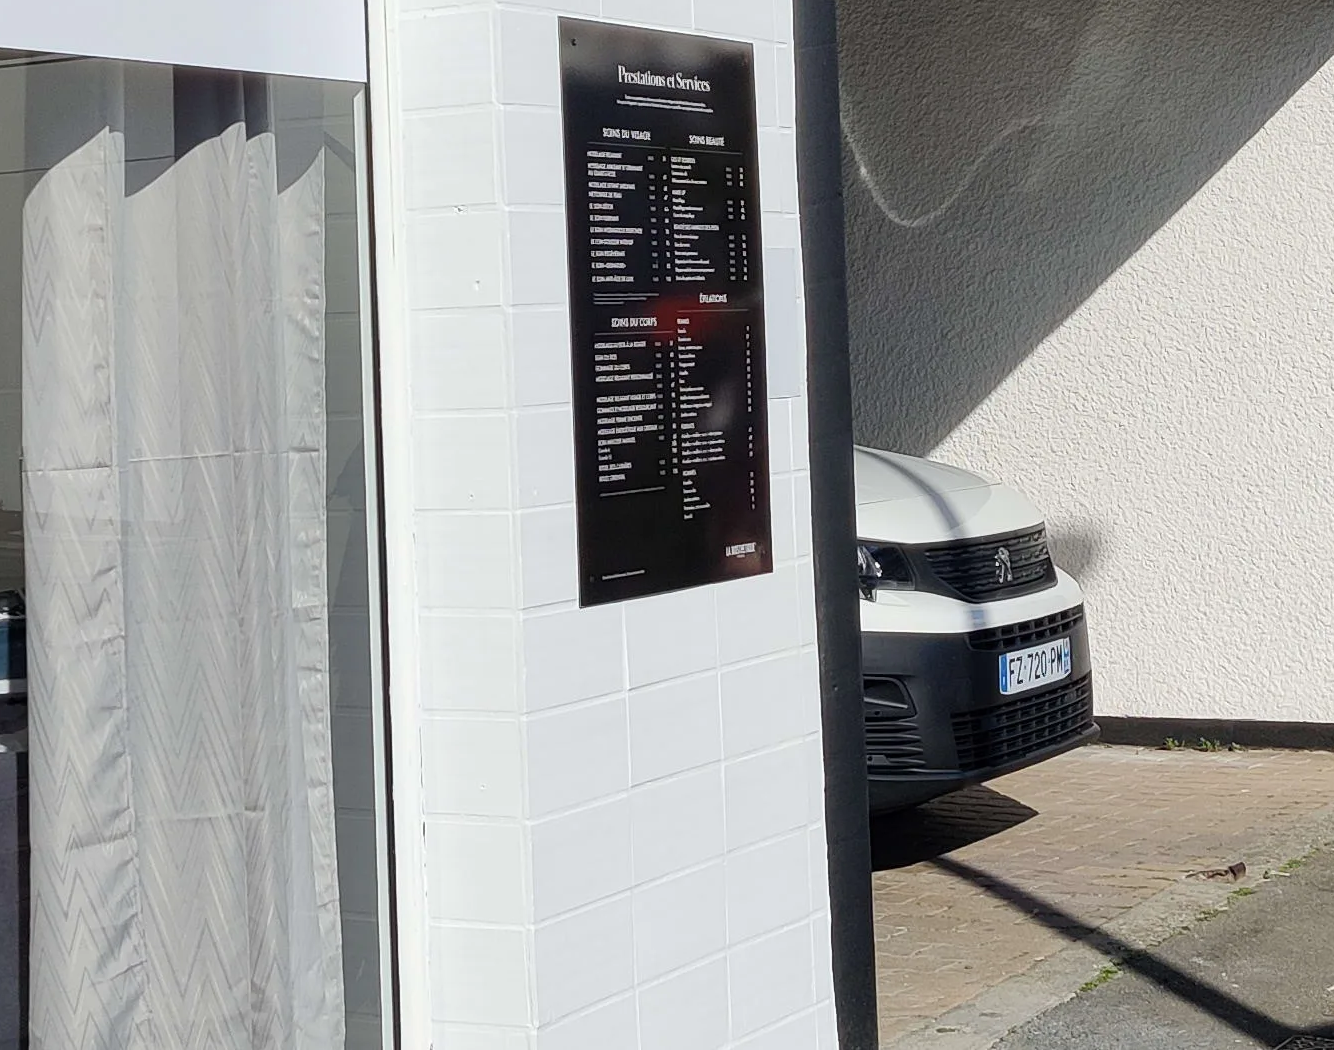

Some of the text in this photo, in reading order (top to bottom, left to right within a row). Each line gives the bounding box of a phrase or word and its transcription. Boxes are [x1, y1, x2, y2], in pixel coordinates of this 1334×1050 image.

[618, 64, 711, 92] Prestations et Services
